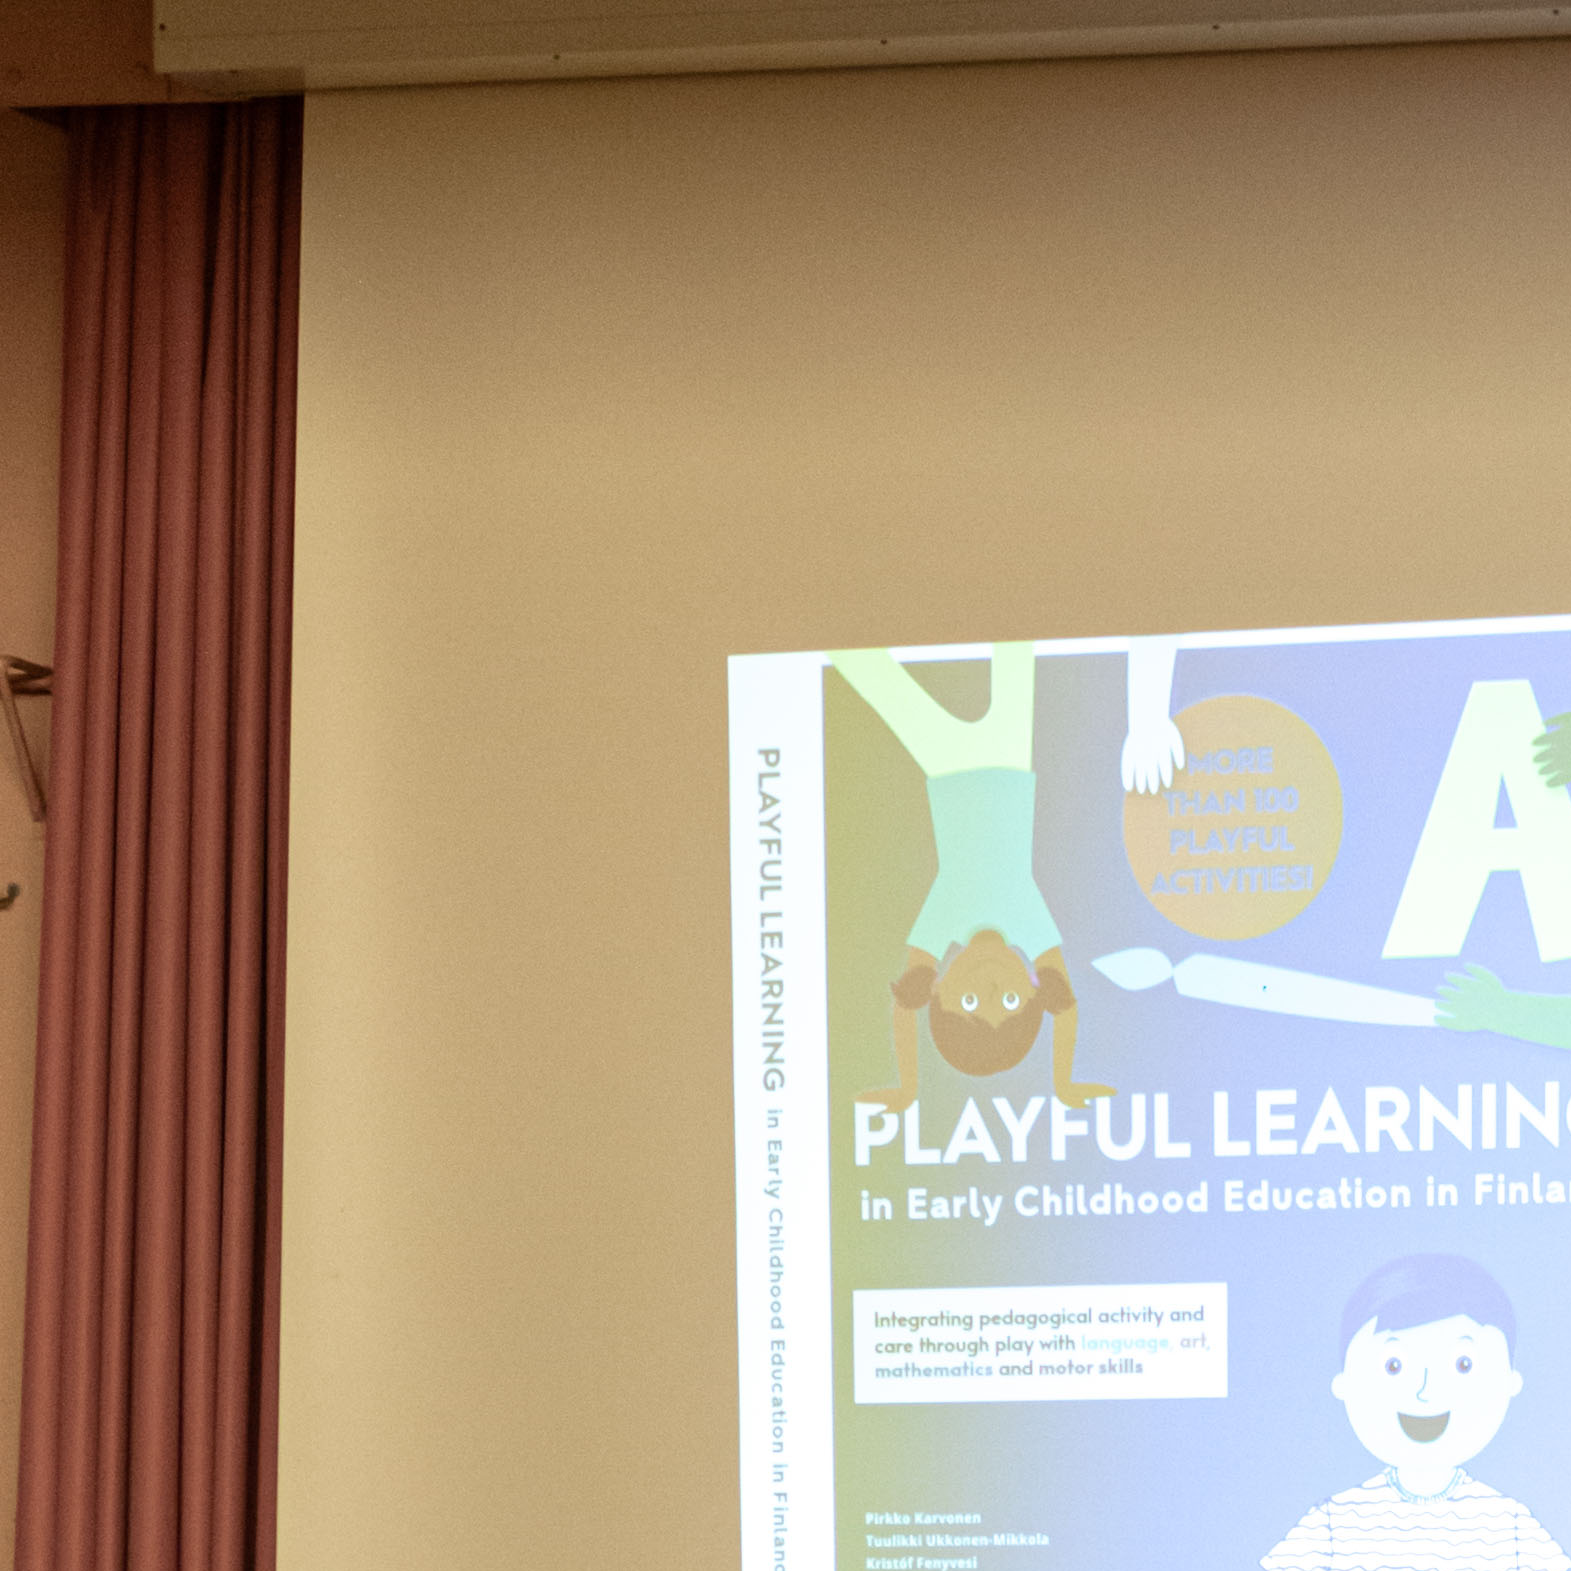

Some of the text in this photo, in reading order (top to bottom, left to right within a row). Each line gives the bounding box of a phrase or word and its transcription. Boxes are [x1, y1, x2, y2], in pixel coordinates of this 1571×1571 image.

[1188, 747, 1274, 775] MORE
[1163, 786, 1299, 816] THAN 100
[757, 748, 782, 901] PLAYFUL
[1169, 826, 1295, 854] PLAYFUL
[1150, 865, 1314, 895] ACTIVITIES!
[760, 912, 785, 1092] LEARNING
[767, 1109, 783, 1128] in
[855, 1093, 1190, 1165] PLAYFUL
[764, 1140, 783, 1199] Early
[861, 1190, 891, 1219] in
[908, 1186, 1002, 1225] Early
[1014, 1181, 1207, 1216] Childhood
[1224, 1177, 1410, 1211] Education
[1426, 1176, 1458, 1206] in
[768, 1208, 785, 1330] Childhood
[874, 1304, 1204, 1332] Integrating pedagogical activity and
[874, 1341, 913, 1354] care
[919, 1335, 989, 1357] through
[994, 1335, 1034, 1357] play
[1038, 1333, 1075, 1351] with
[1179, 1331, 1210, 1351] art,
[874, 1357, 1143, 1378] mathematics and motor skills
[771, 1340, 788, 1453] Education
[773, 1464, 789, 1482] in
[865, 1512, 981, 1524] Pirkko Karvonen
